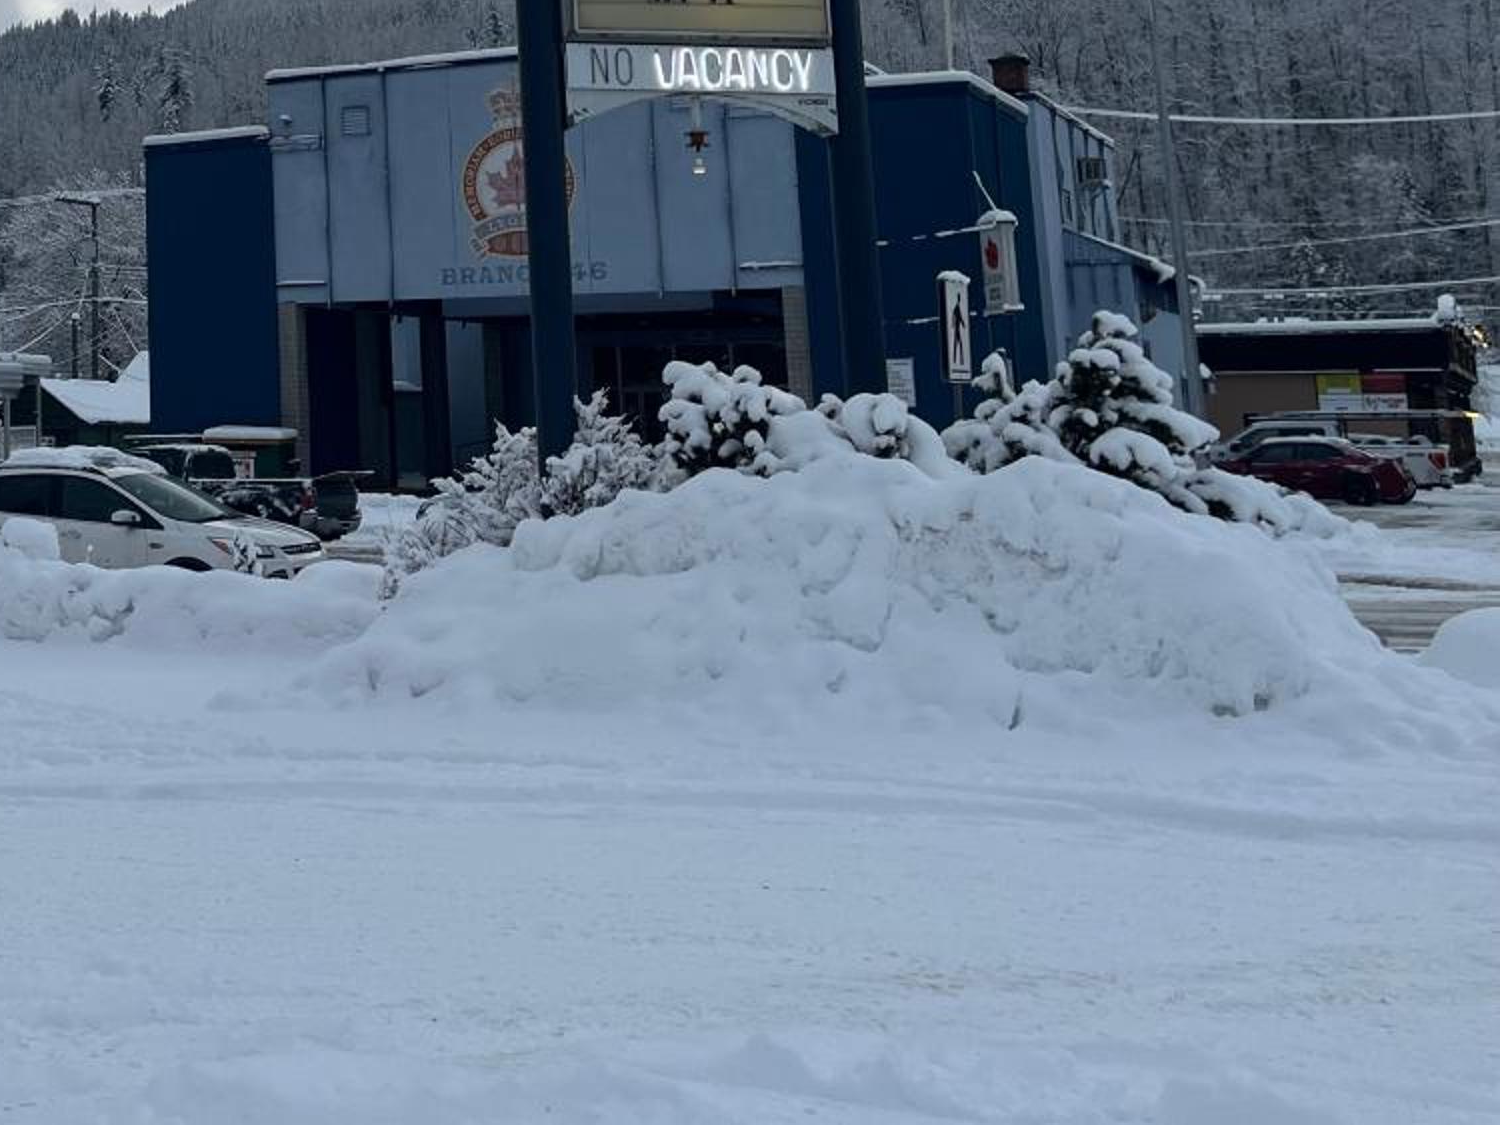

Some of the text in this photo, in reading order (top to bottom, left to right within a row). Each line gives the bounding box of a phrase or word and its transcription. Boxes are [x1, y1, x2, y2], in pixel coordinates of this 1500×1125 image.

[590, 47, 813, 92] NO VACANCY
[442, 264, 529, 284] BRANC
